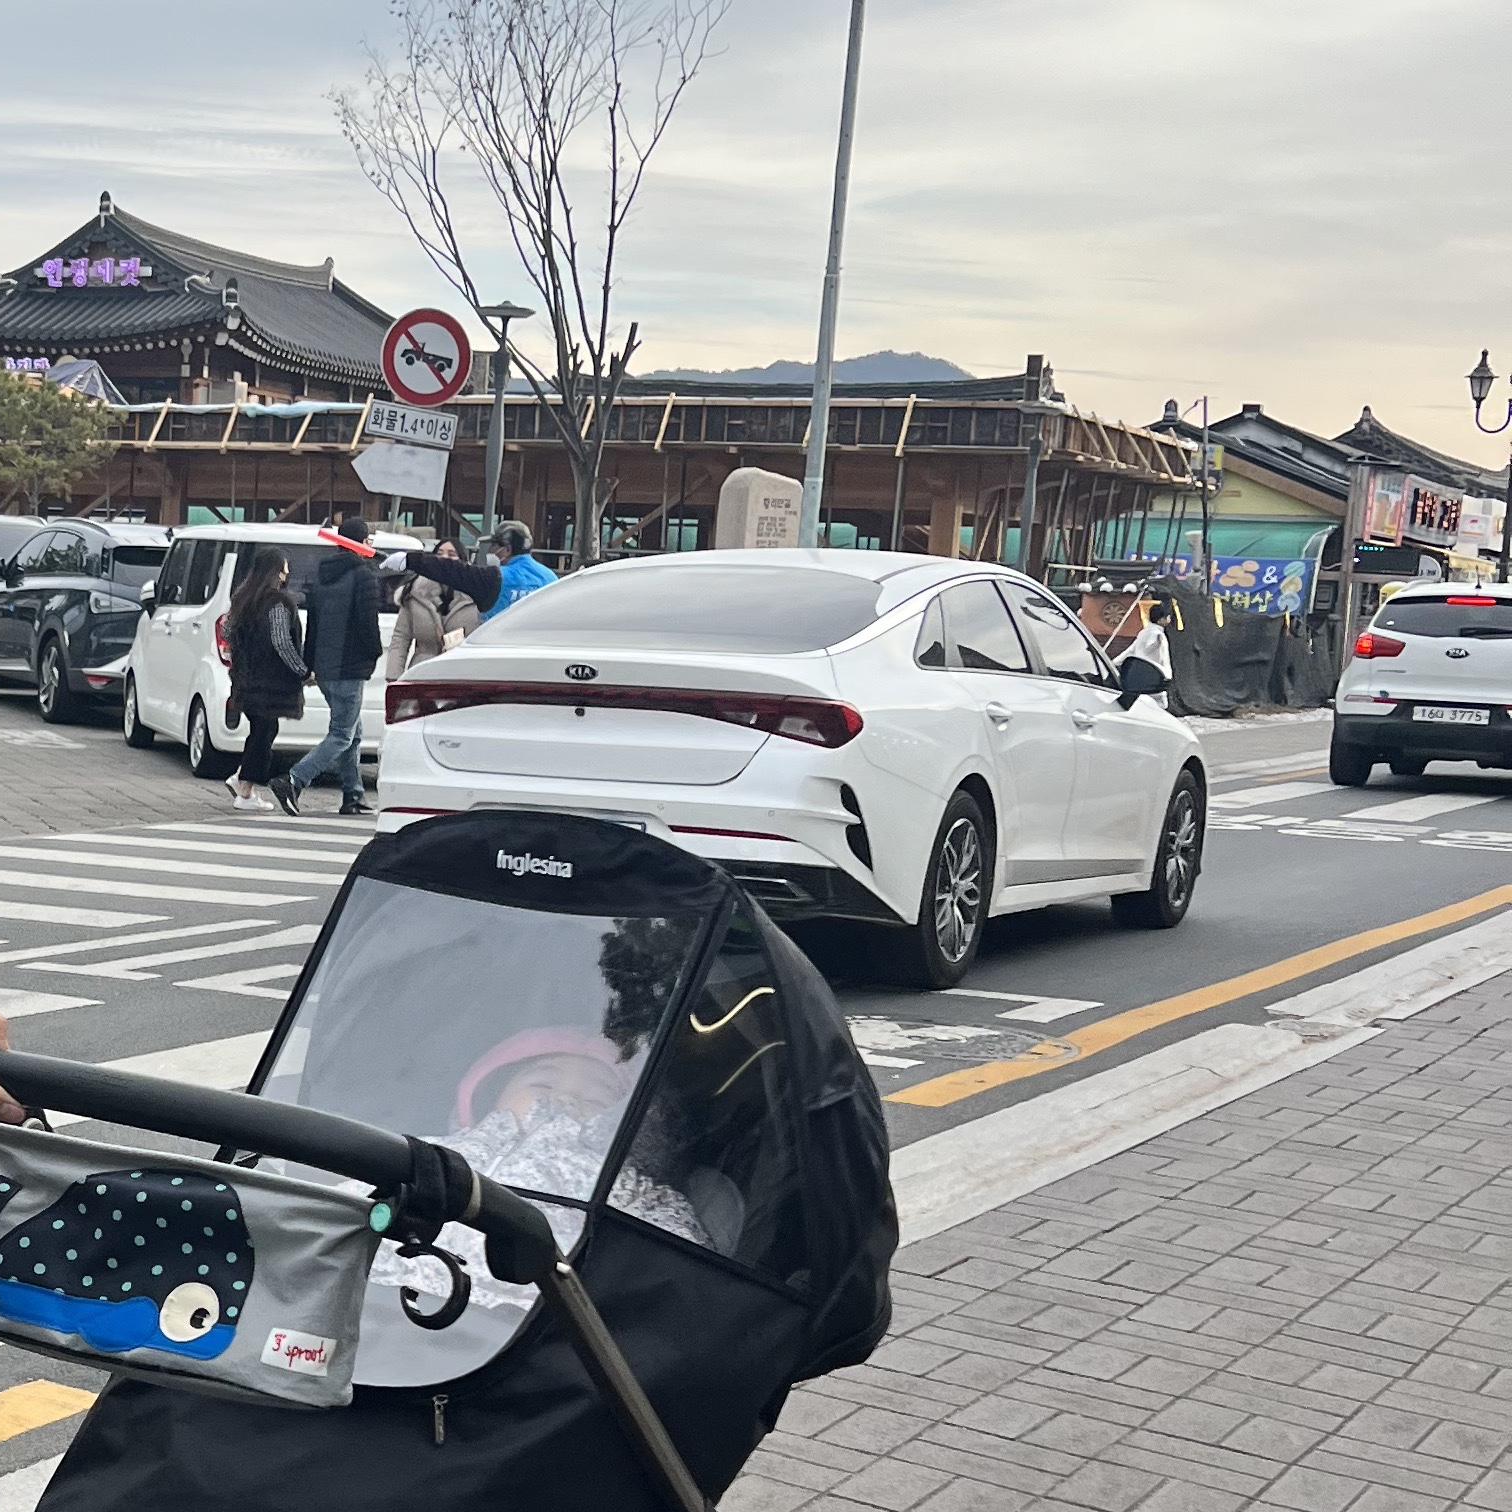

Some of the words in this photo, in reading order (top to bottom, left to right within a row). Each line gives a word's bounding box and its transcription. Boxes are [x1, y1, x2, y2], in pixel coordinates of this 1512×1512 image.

[567, 665, 596, 679] KIA
[1449, 710, 1483, 722] 3775
[496, 849, 574, 878] Inglesina
